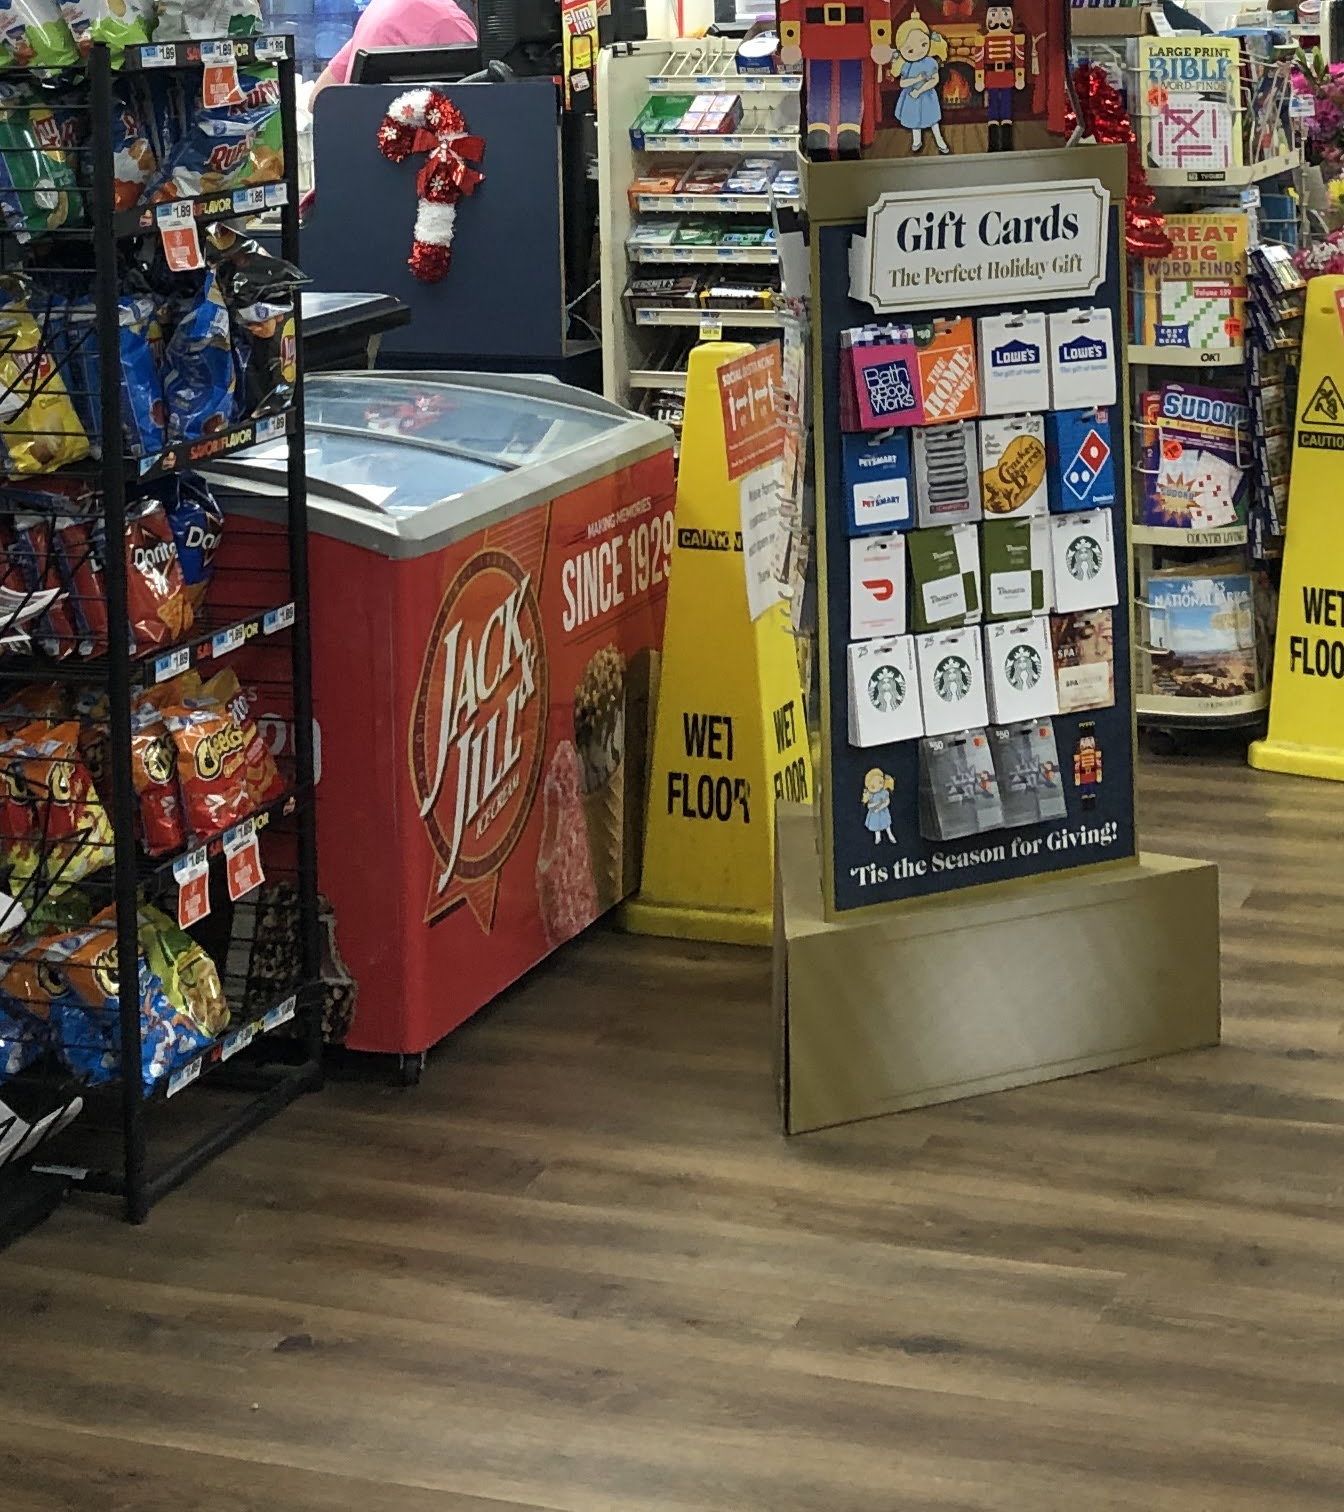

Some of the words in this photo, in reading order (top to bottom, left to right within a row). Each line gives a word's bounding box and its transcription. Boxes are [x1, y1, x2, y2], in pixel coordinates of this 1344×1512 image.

[1148, 47, 1186, 58] LARGE
[1187, 47, 1230, 58] PRINT
[1148, 57, 1233, 82] BIBLE
[896, 210, 967, 255] Gift
[978, 204, 1079, 247] Cards
[1166, 226, 1238, 242] REAT
[1170, 245, 1218, 261] BIG
[889, 266, 920, 288] The
[924, 263, 984, 287] Perfect
[987, 258, 1050, 284] Holiday
[1052, 254, 1083, 276] Gift
[996, 348, 1037, 364] LOWE'S
[1063, 344, 1103, 361] LOWE'S
[863, 364, 910, 389] Bath
[924, 347, 974, 419] HOME
[926, 356, 949, 386] THE
[871, 395, 916, 414] Works
[1163, 392, 1249, 426] SUDOKU
[858, 454, 897, 468] PETSMART
[615, 496, 652, 525] MEMORIES
[862, 495, 900, 508] PETSMART
[681, 530, 743, 550] CAUTION
[561, 535, 624, 633] SINCE
[627, 509, 674, 596] 1929
[419, 573, 531, 817] JACK
[682, 712, 736, 761] WET
[771, 700, 797, 753] WET
[436, 687, 523, 895] JILL
[773, 756, 808, 802] FLOOR
[666, 774, 751, 824] FLOOR
[894, 857, 928, 880] the
[930, 840, 1007, 874] Season
[1010, 833, 1043, 858] for
[1044, 821, 1119, 854] Giving!
